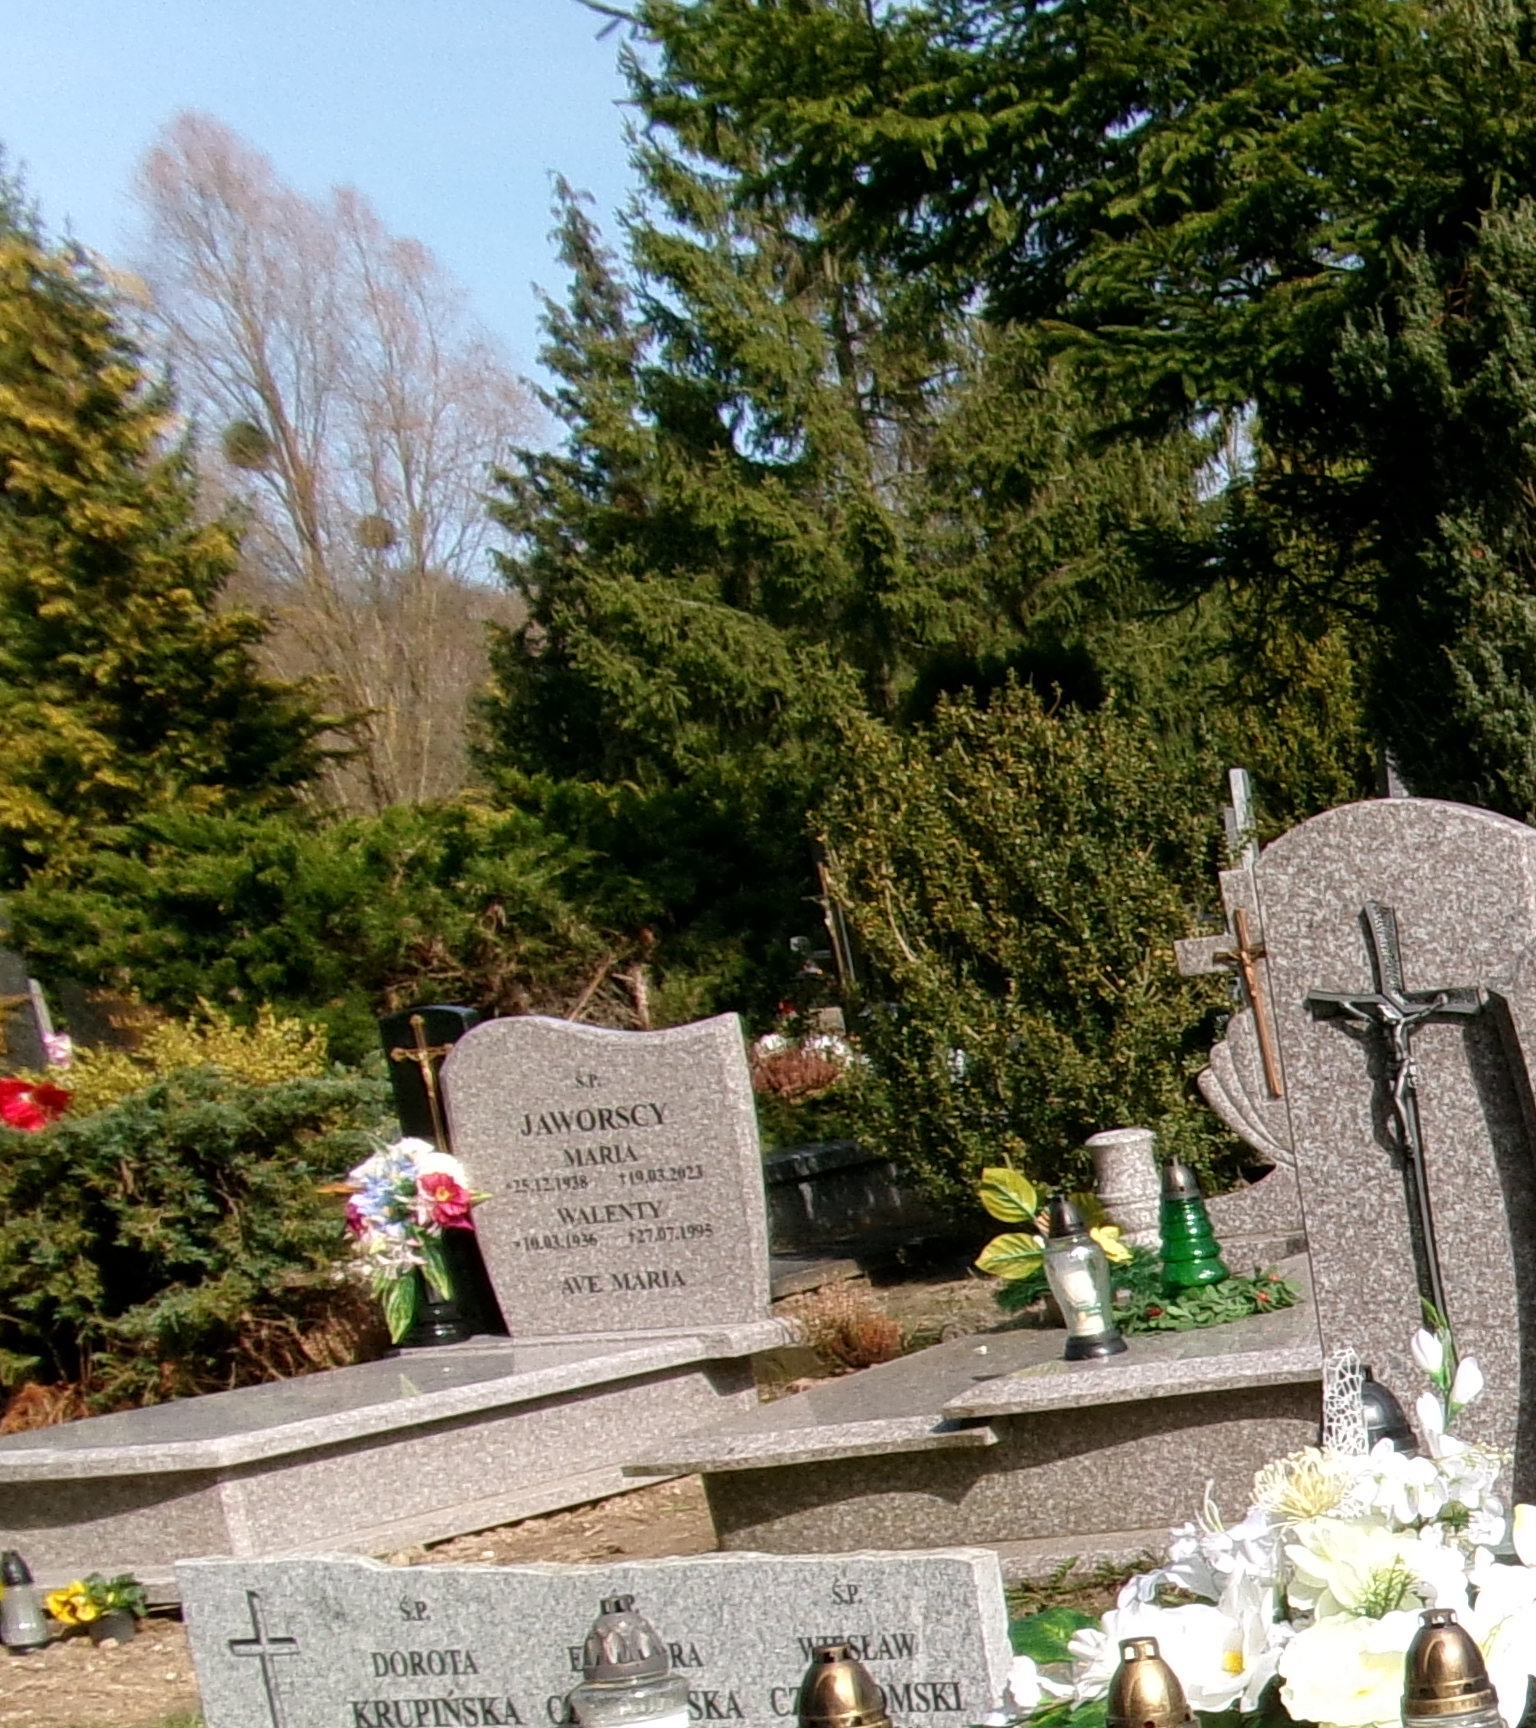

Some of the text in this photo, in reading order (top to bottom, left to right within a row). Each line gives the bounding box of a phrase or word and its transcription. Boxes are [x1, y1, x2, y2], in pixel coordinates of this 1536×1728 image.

[521, 1102, 667, 1136] JAWORSCY
[563, 1144, 639, 1168] MARIA
[557, 1201, 663, 1226] WALENTY
[562, 1270, 686, 1295] AVE MARIA
[371, 1650, 479, 1677] DOROTA
[351, 1689, 527, 1728] KRUPIŃSKA
